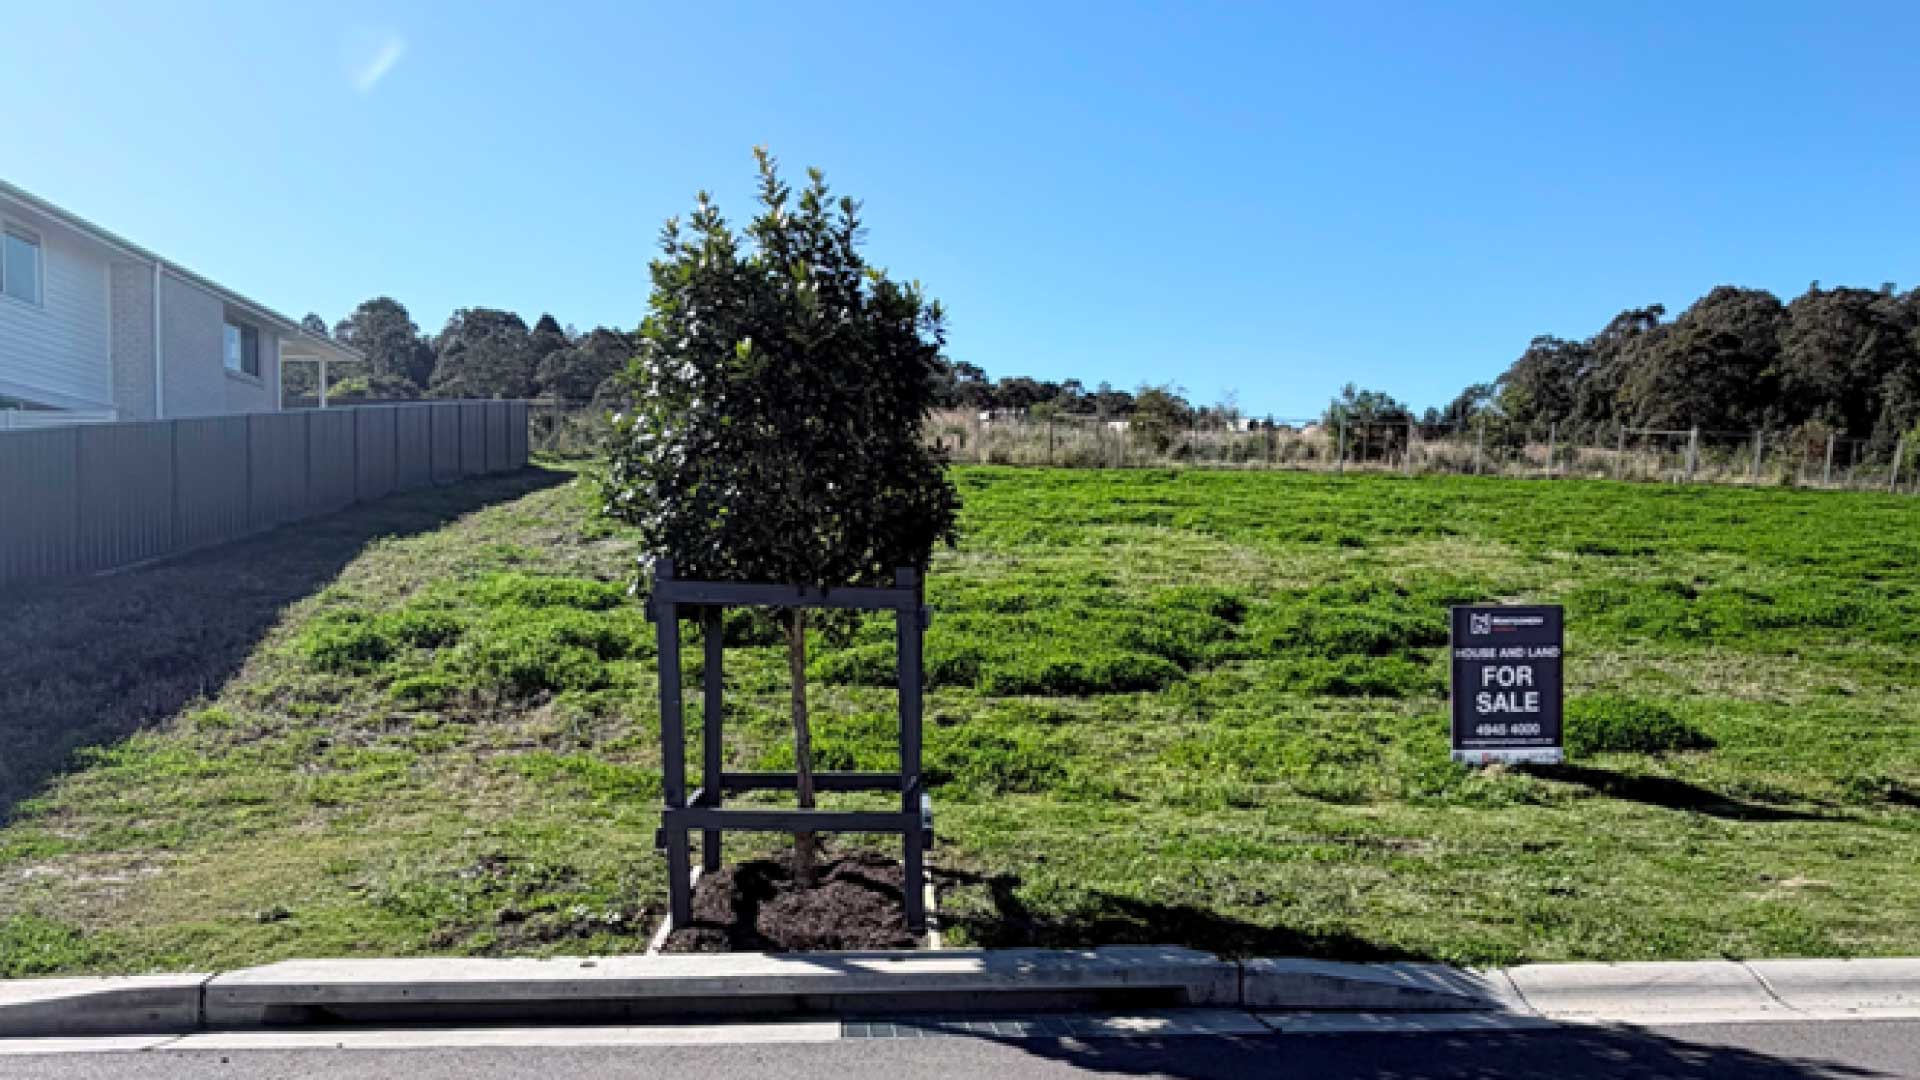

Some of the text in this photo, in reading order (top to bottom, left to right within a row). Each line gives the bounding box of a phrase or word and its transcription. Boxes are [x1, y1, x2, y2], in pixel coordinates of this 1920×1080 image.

[1455, 646, 1560, 659] HOUSE AND LAND
[1482, 665, 1534, 687] FOR
[1475, 691, 1541, 714] SALE
